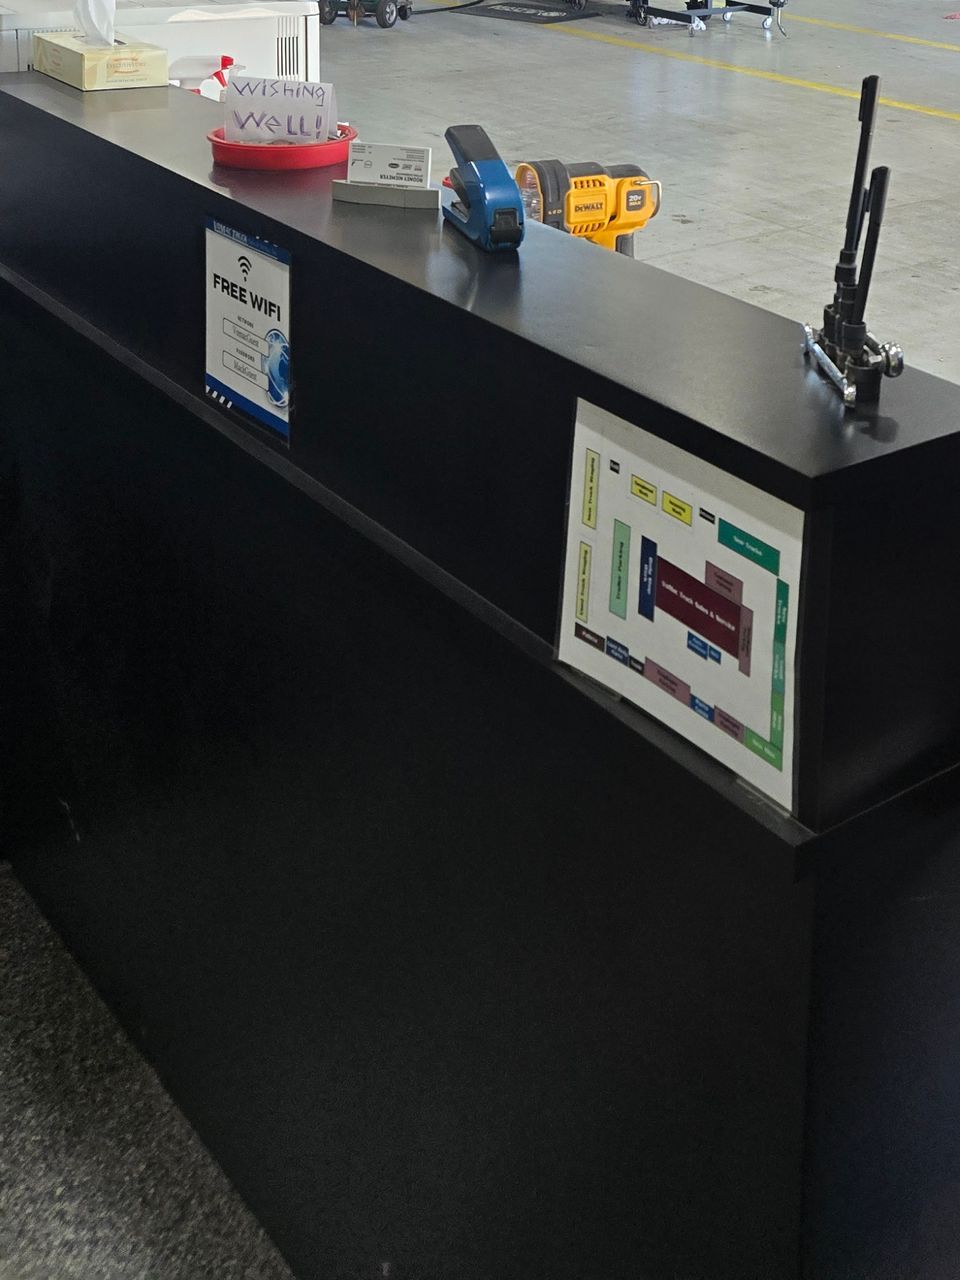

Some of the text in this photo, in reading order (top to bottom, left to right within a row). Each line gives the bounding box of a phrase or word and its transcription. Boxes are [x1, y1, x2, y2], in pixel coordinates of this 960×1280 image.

[213, 273, 281, 322] FREE WIFI
[679, 591, 694, 605] Truck
[695, 601, 709, 615] Sales
[715, 614, 736, 632] Service
